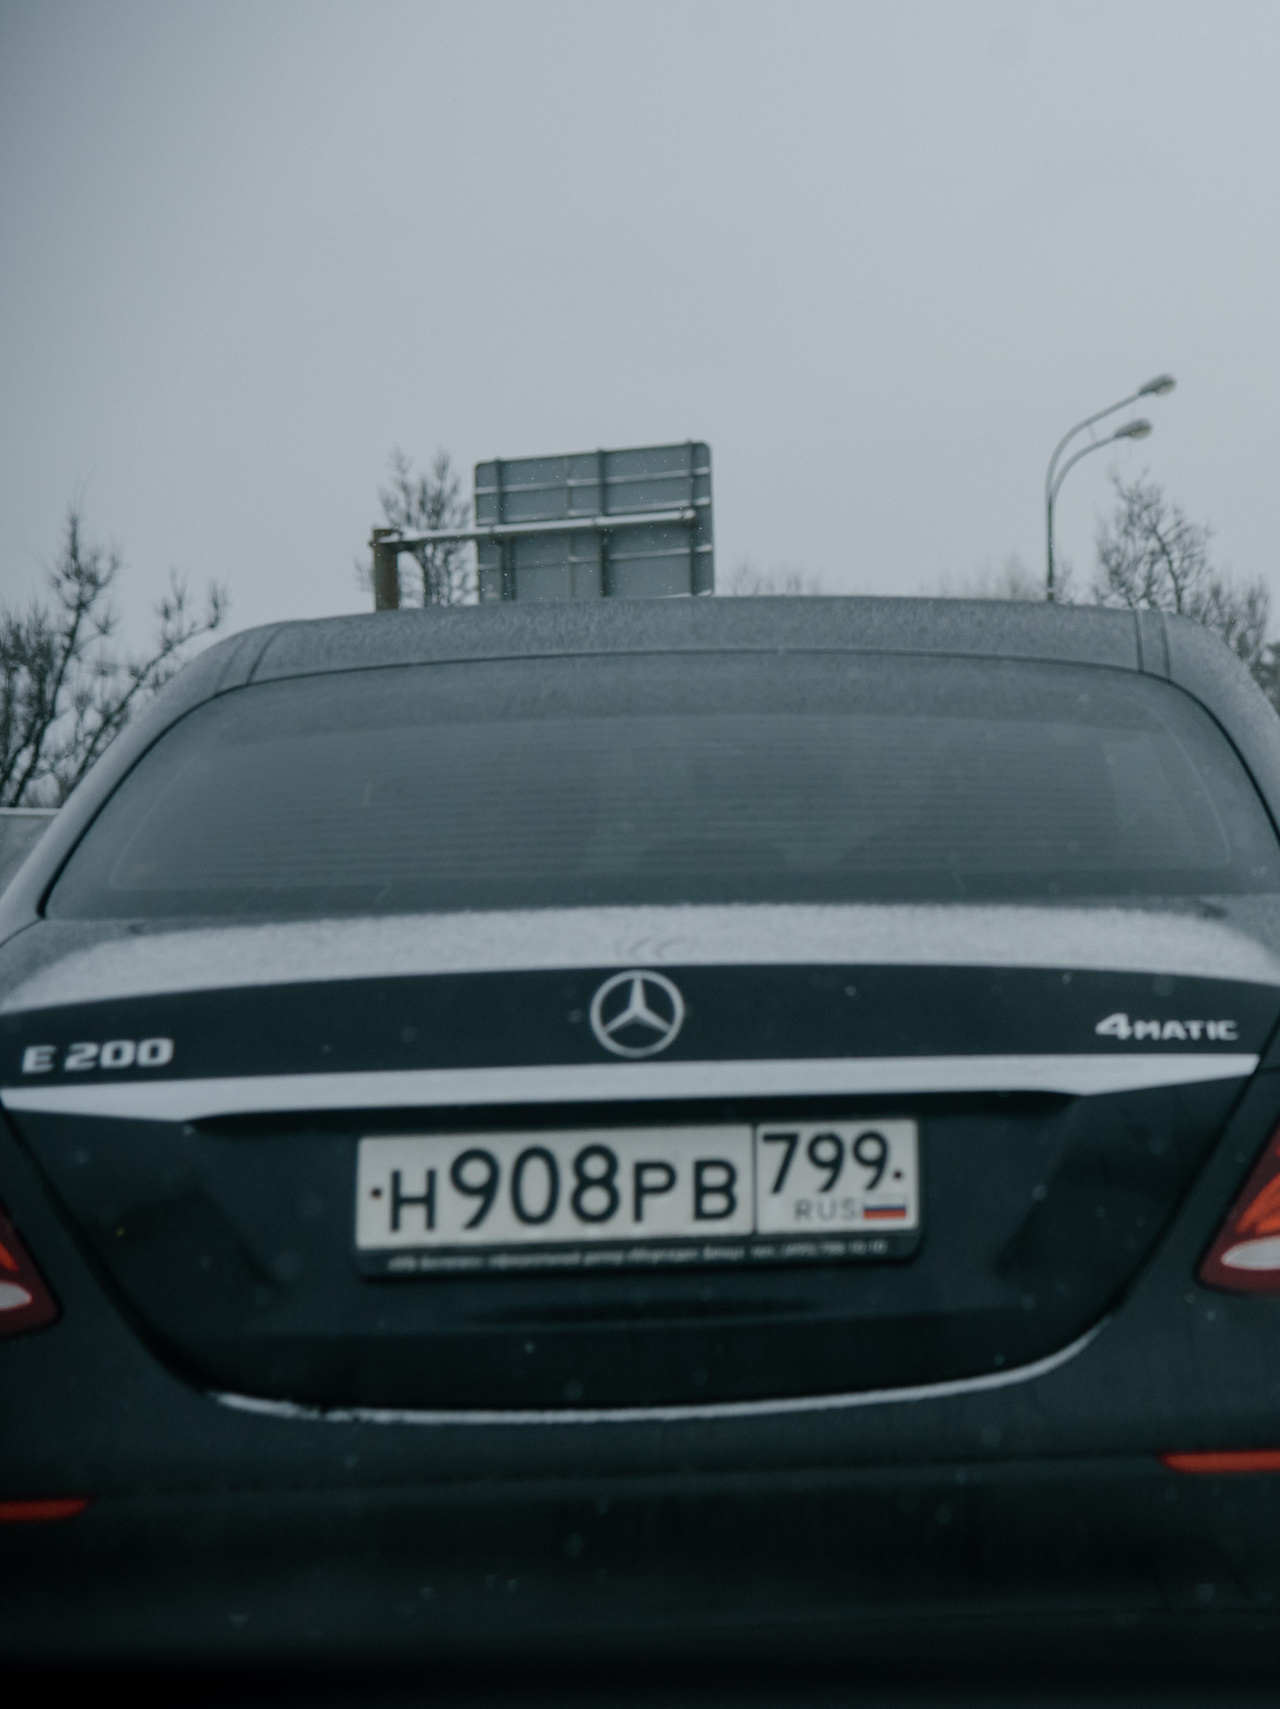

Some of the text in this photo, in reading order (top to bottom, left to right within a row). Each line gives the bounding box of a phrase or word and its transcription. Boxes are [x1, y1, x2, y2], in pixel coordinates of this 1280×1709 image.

[1095, 1012, 1240, 1041] 4MATIC
[21, 1037, 174, 1074] E 200
[762, 1130, 889, 1195] 799
[795, 1198, 858, 1221] RUS
